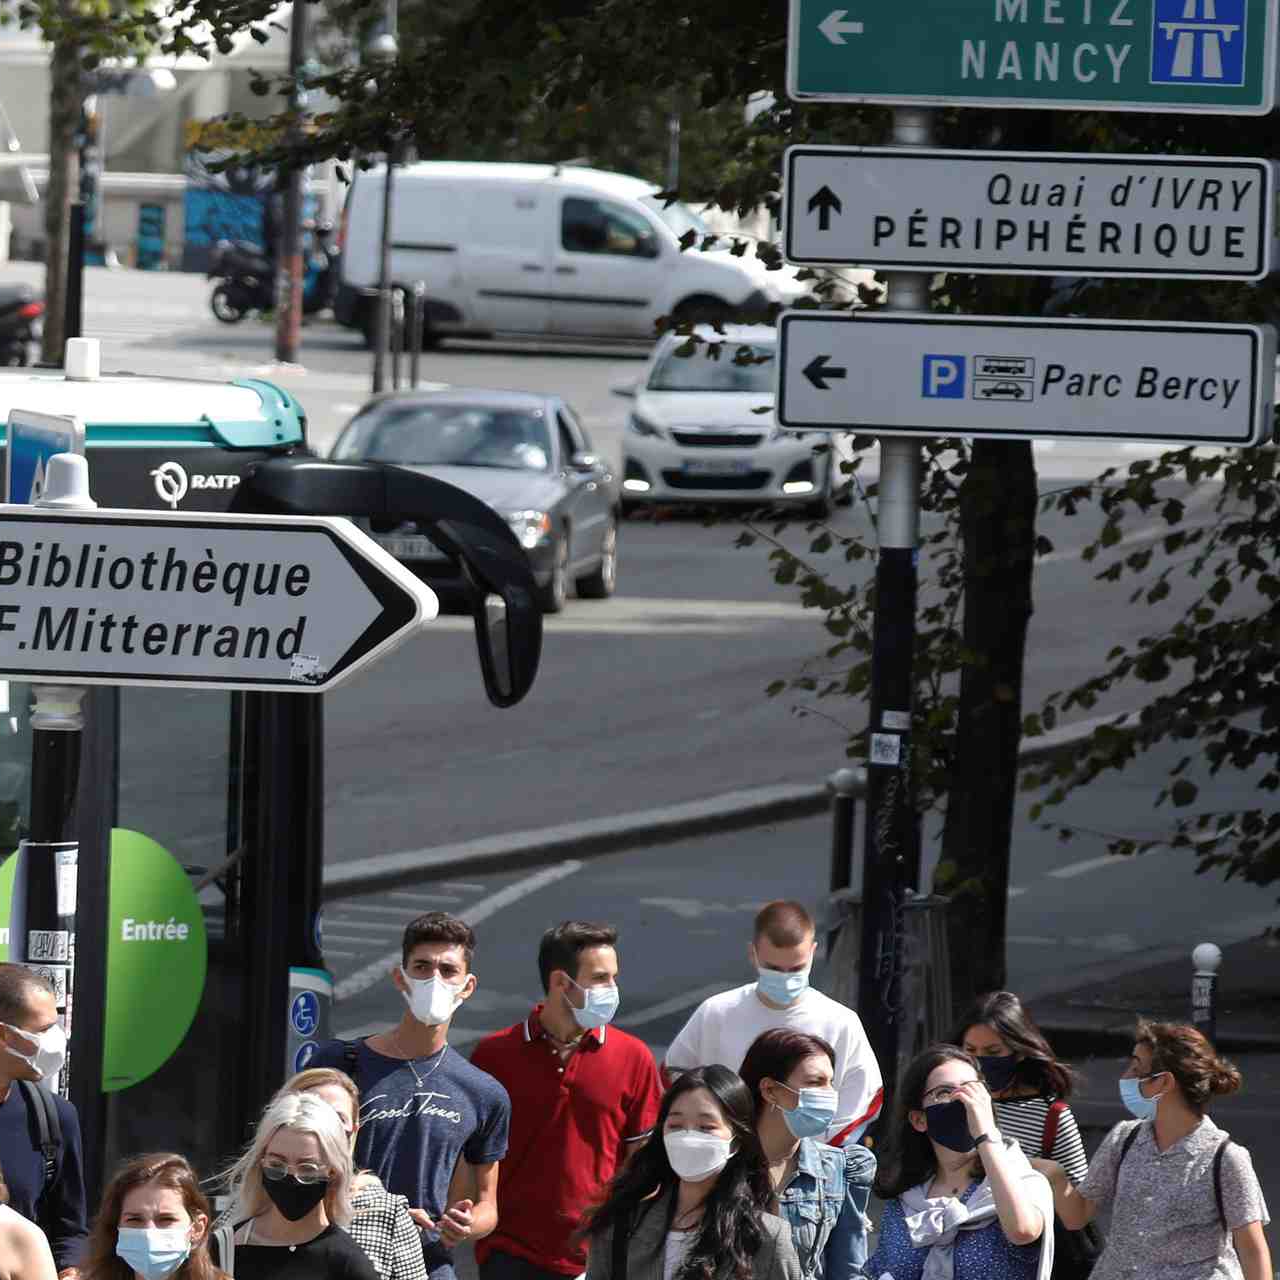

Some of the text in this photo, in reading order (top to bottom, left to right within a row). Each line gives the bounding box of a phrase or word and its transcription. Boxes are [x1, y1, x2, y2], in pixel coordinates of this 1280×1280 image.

[994, 0, 1135, 26] METZ
[959, 39, 1133, 84] NANCY
[986, 172, 1254, 213] Quai d'IVRY
[872, 209, 1246, 258] PÉRIPHÉRIQUE
[1040, 363, 1122, 399] Parc
[1135, 366, 1241, 409] Bercy
[190, 474, 241, 490] RATP
[121, 916, 189, 942] Entrée
